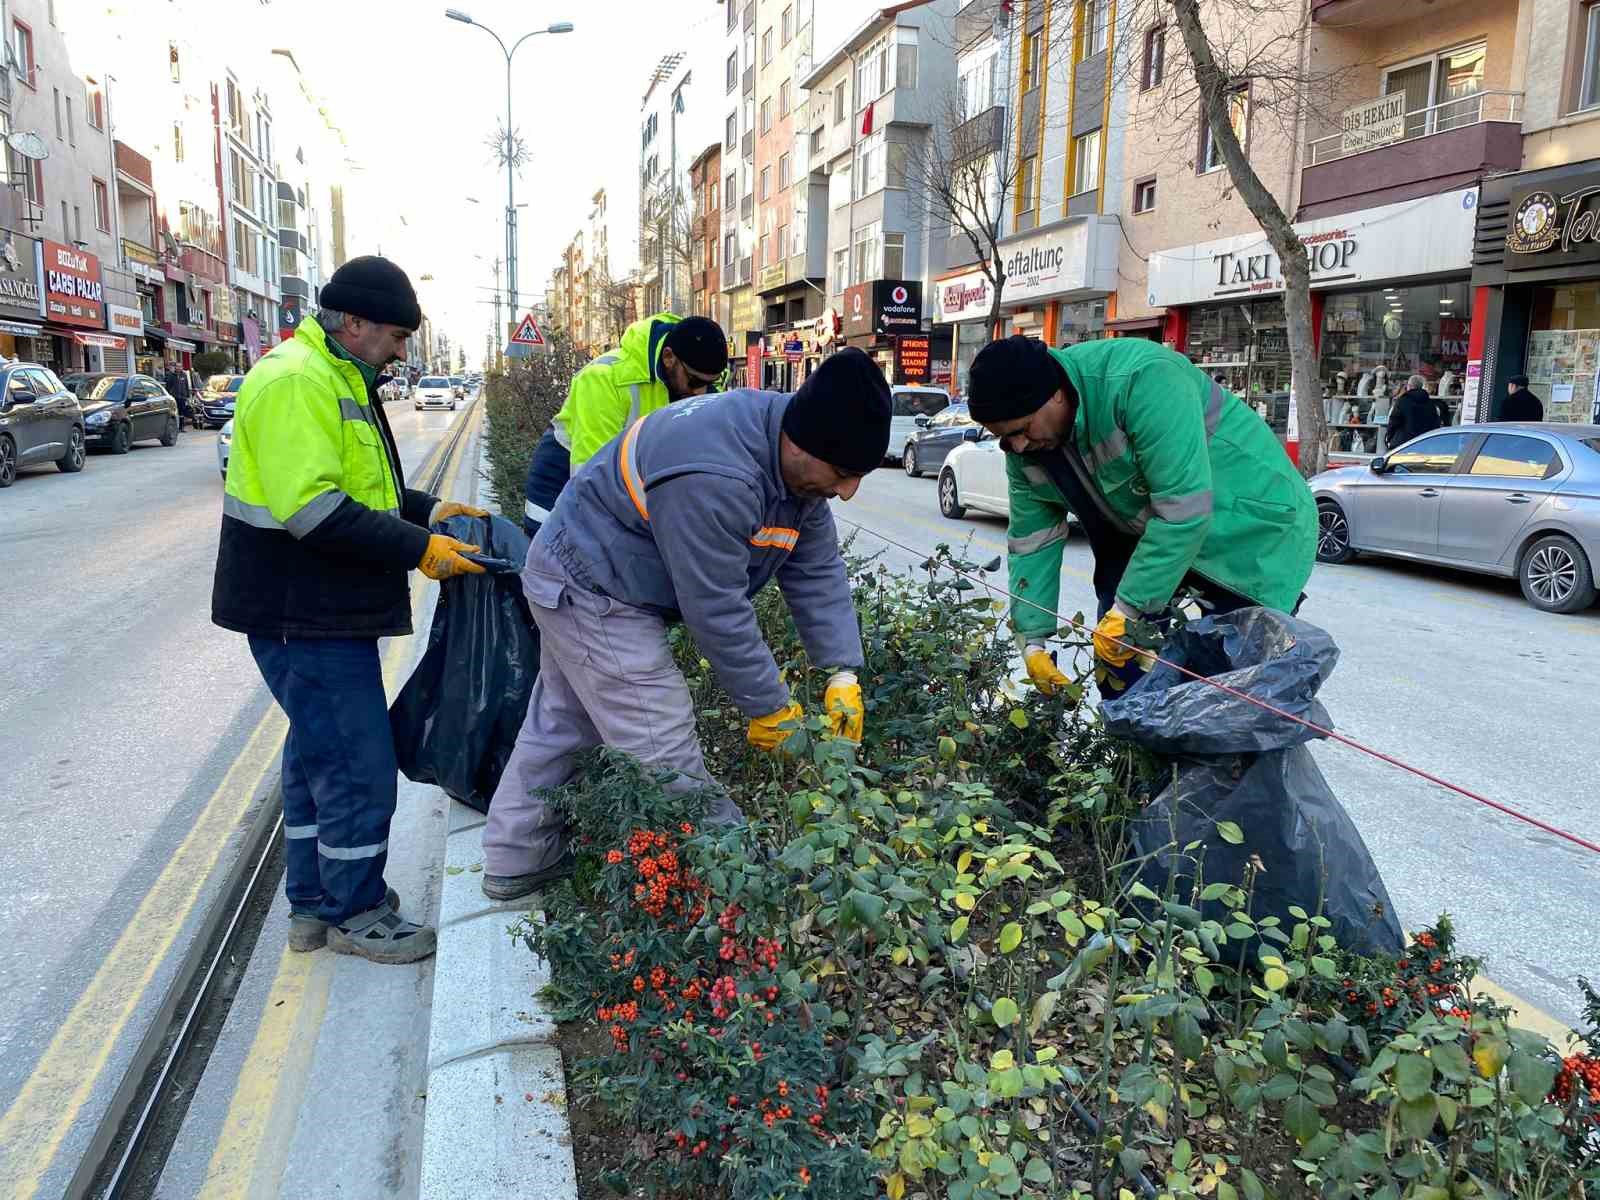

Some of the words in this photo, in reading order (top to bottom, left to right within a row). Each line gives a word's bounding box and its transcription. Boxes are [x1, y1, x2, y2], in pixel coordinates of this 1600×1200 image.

[1214, 252, 1271, 285] TAKI
[48, 270, 76, 297] ÇARŞI
[77, 278, 102, 302] PAZAR
[883, 305, 916, 313] vodafone
